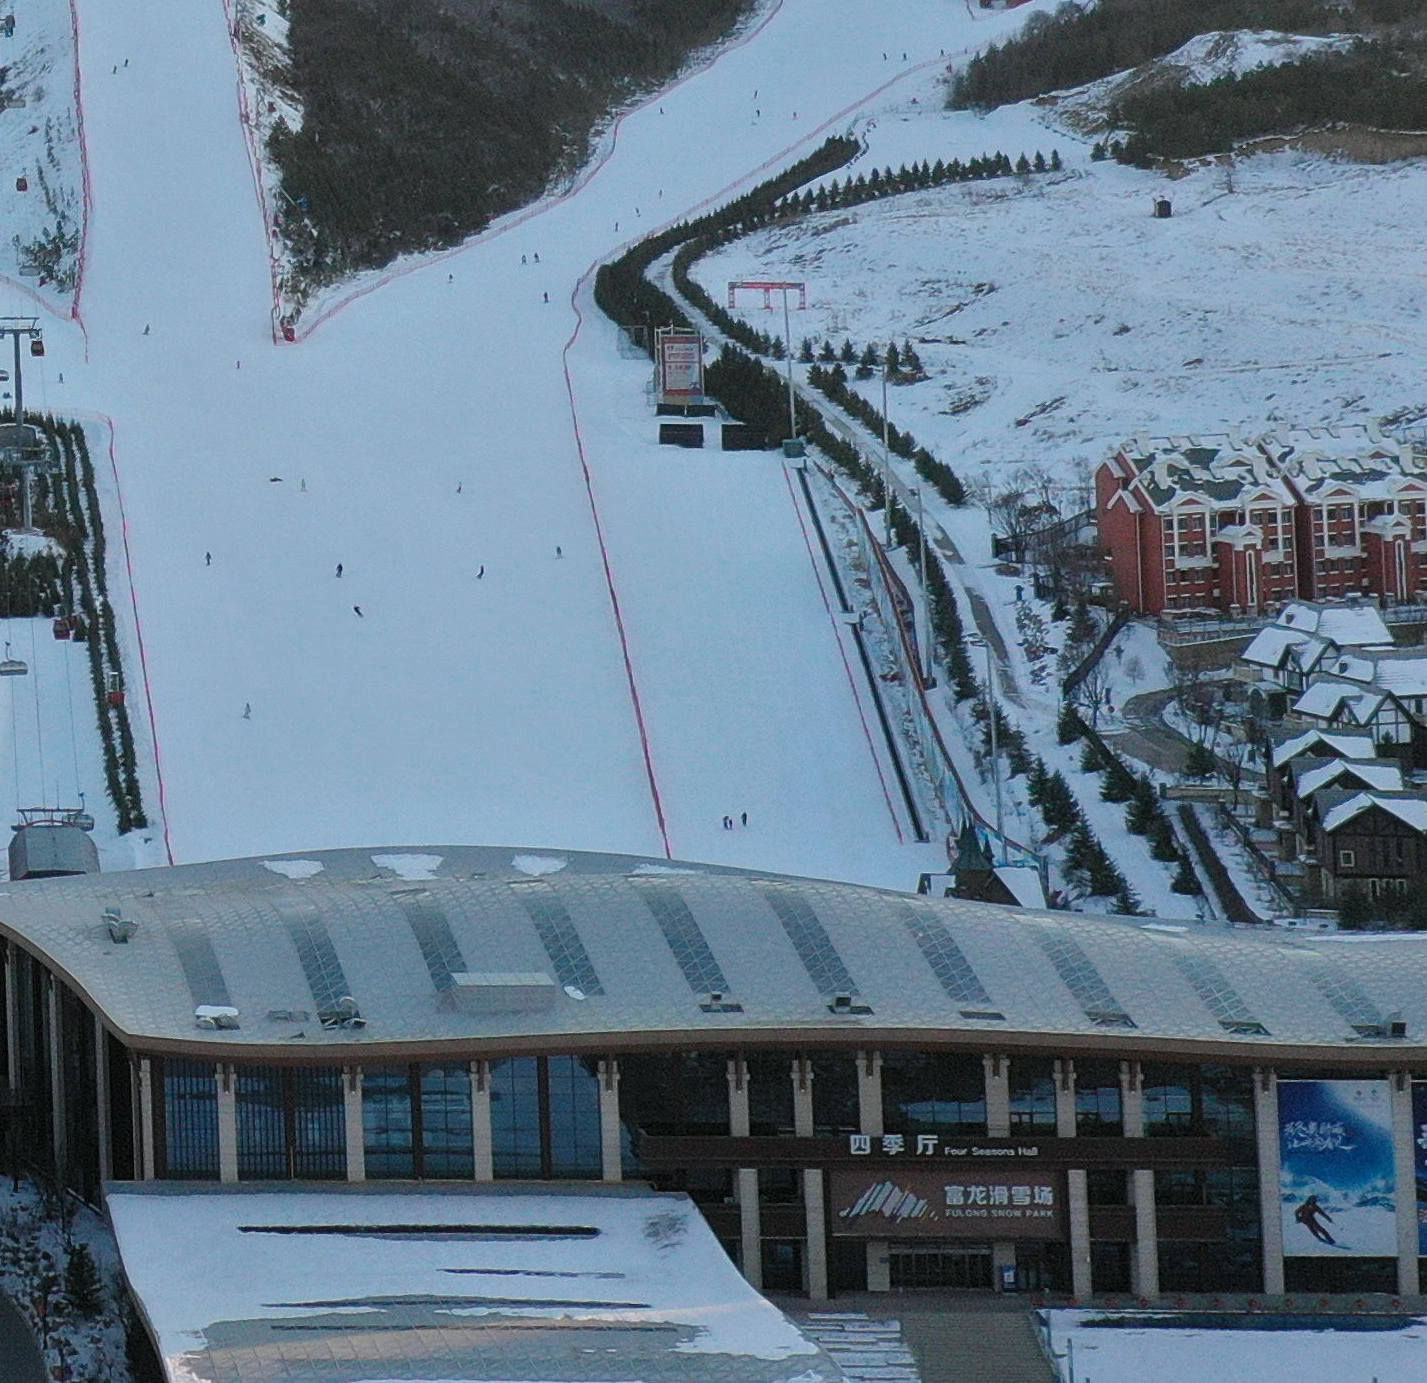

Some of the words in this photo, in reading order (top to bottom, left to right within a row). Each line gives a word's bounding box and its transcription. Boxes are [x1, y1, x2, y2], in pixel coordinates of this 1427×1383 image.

[850, 1134, 939, 1155] 四季厅
[945, 1147, 967, 1156] Four
[972, 1147, 1014, 1156] Seasons
[1018, 1147, 1038, 1156] Hall
[945, 1186, 1054, 1205] 富龙滑雪场
[946, 1209, 987, 1217] FULONG
[991, 1209, 1021, 1217] SNOW
[1026, 1209, 1054, 1217] PARK
